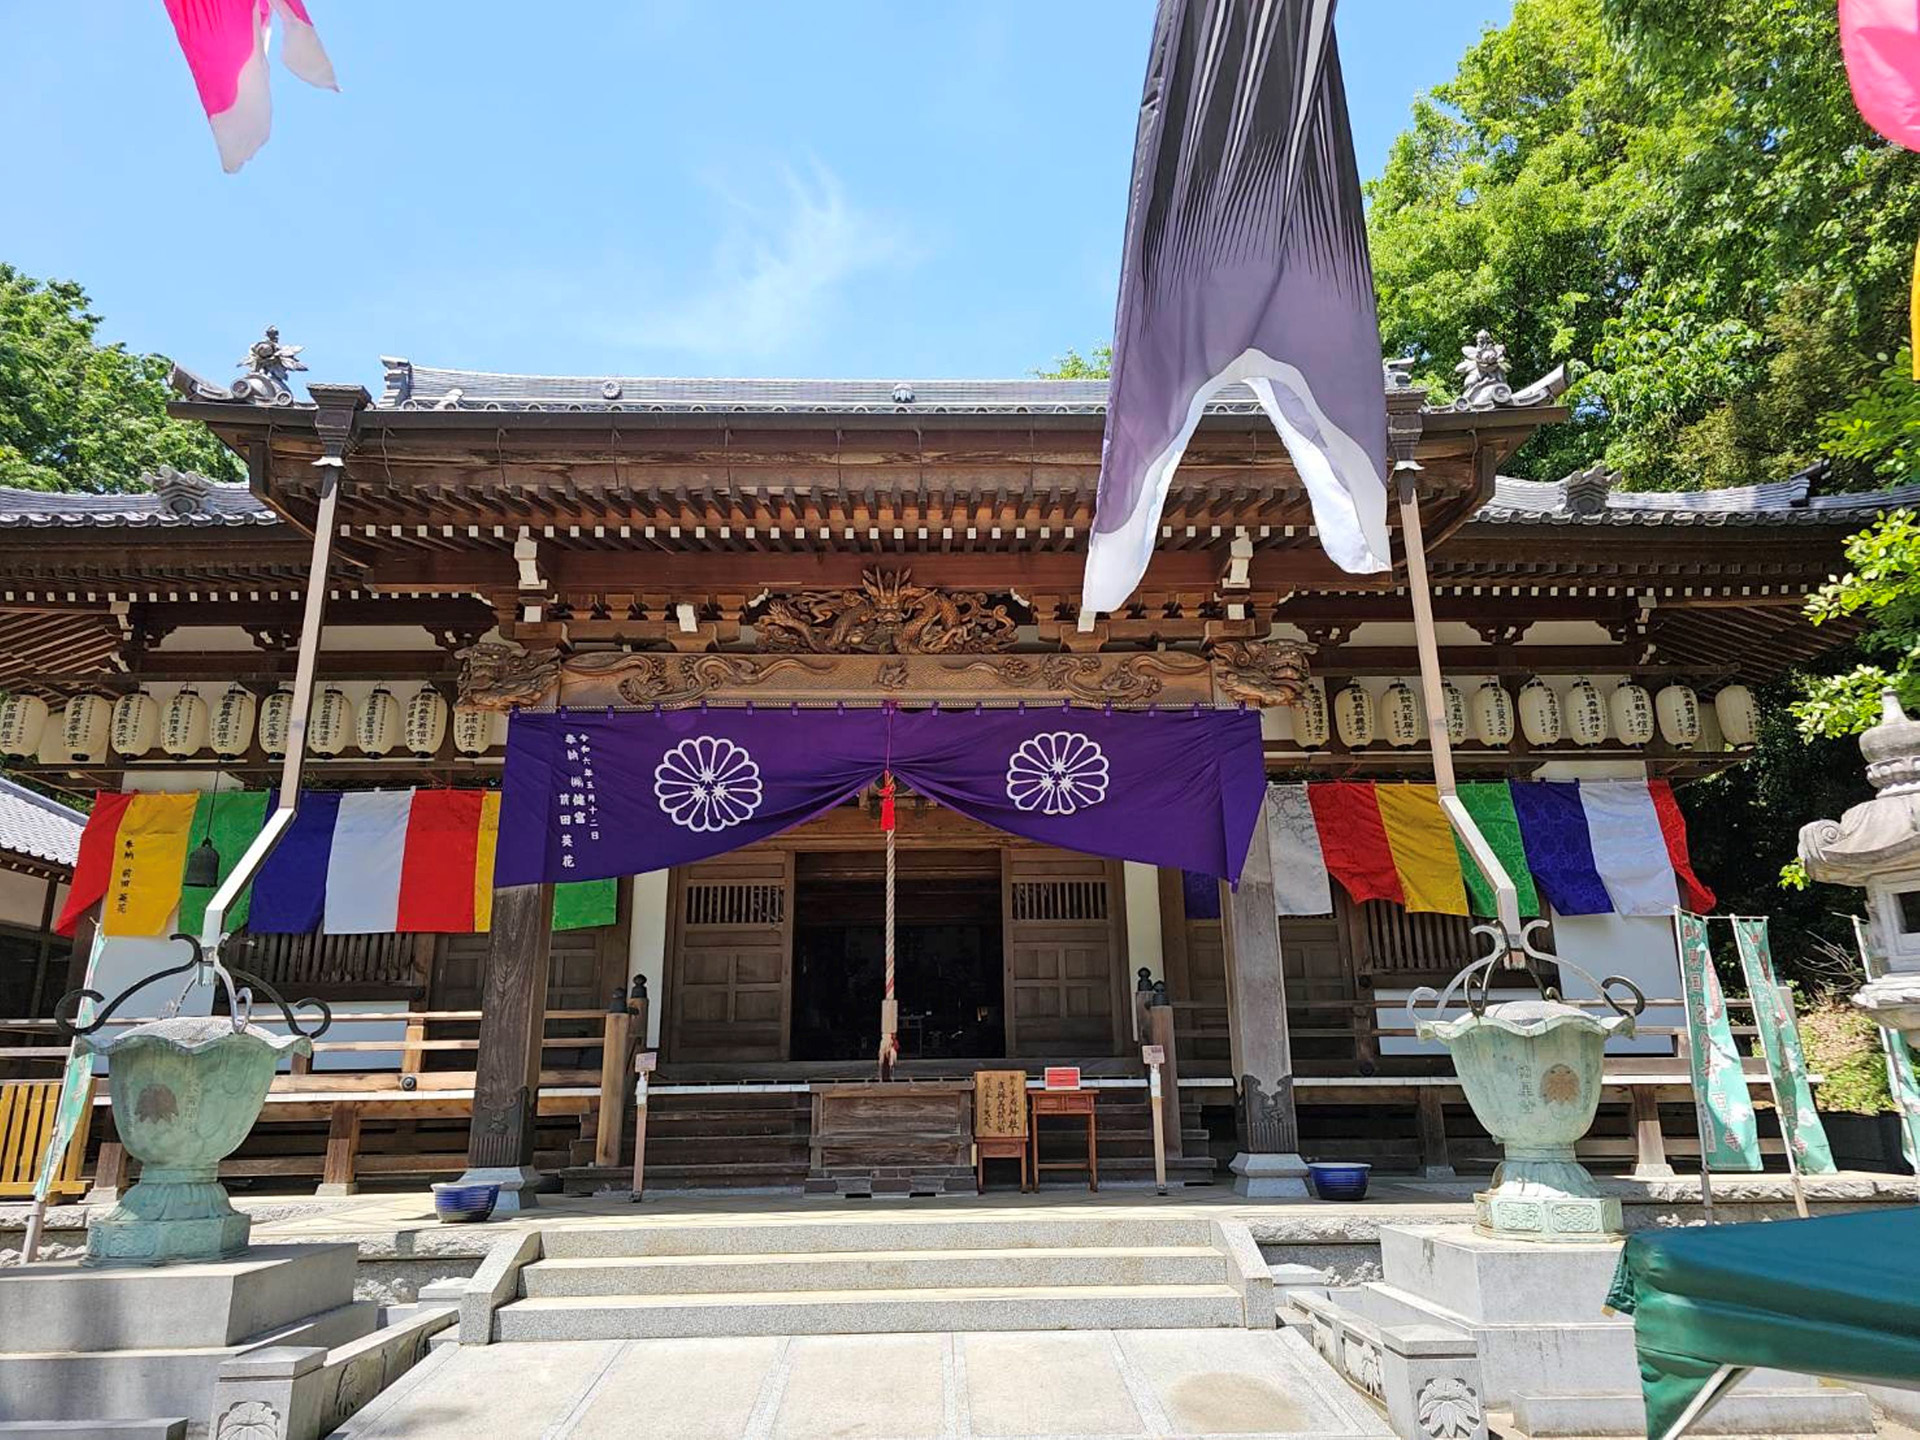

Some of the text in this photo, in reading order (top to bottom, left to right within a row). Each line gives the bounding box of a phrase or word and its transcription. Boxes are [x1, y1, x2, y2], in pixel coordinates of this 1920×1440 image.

[565, 733, 579, 761] 奉納
[579, 733, 600, 840] 令和六年五月十二日
[559, 794, 575, 868] 前田英花
